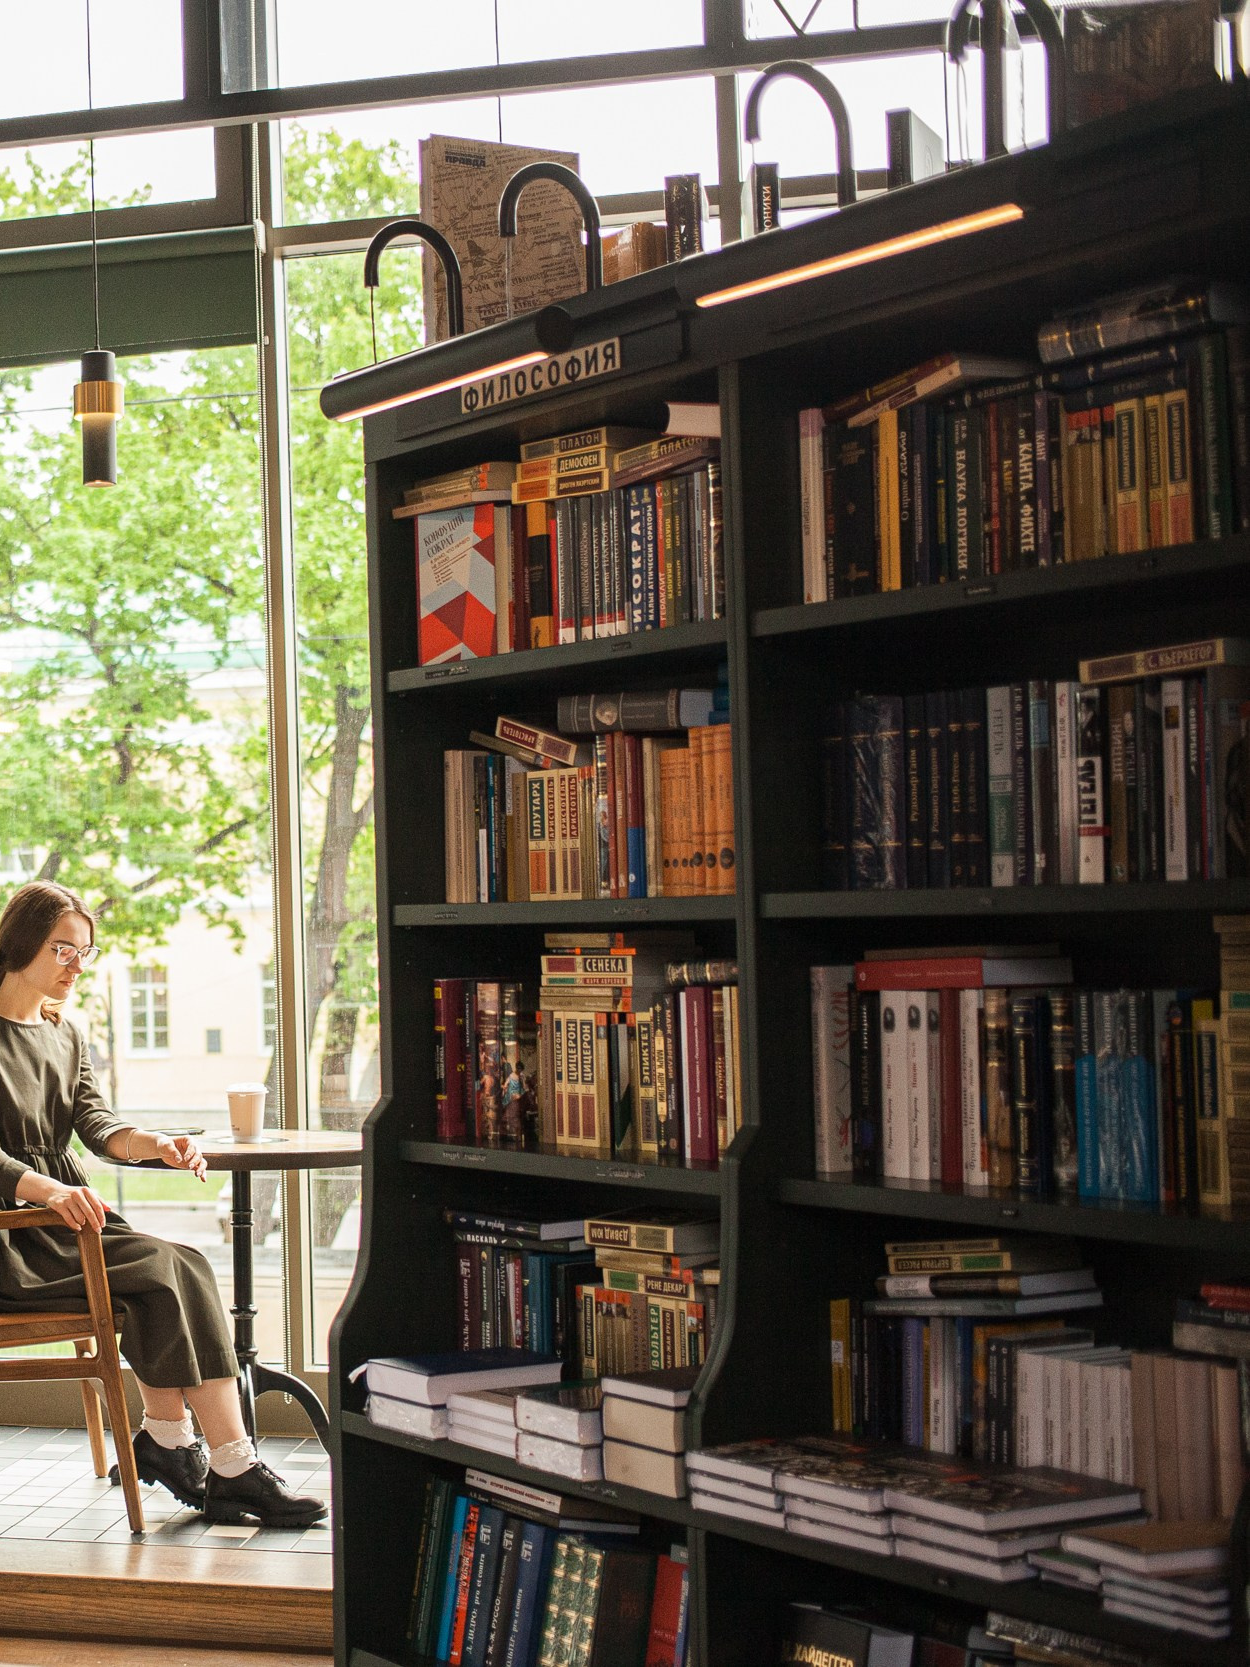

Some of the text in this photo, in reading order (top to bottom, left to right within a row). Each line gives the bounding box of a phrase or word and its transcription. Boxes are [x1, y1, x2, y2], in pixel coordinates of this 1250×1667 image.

[445, 156, 486, 167] ПРАВДА
[463, 341, 617, 413] ФИЛОСОФИЯ
[561, 432, 600, 450] ПЛАТОН
[1121, 415, 1131, 487] ИММАНУИЛ КАНТ
[1149, 412, 1159, 484] ИММАНУИЛ КАНТ
[1172, 405, 1181, 478] ИММАНУИЛ КАНТ
[559, 453, 598, 473] ДЕМОСФЕН
[956, 449, 966, 503] НАУКА
[1019, 443, 1034, 553] КАНТА ФИХТЕ
[424, 512, 465, 547] КОНФУЦИЙ
[427, 534, 455, 557] СОКРАТ
[957, 507, 967, 569] ЛОГИКИ
[630, 510, 642, 623] ИСОКРАТ
[503, 724, 536, 745] АРИСТОТЕЛЬ
[993, 709, 1004, 756] ГЕГЕЛЬ
[1014, 716, 1024, 750] ГЕГЕЛЬ
[532, 782, 541, 837] ПЛУТАРХ
[570, 779, 578, 836] АРИСТОТЕЛЬ
[1077, 760, 1097, 824] ГЕГЕЛЬ
[586, 959, 624, 971] СЕНЕКА
[568, 1023, 578, 1080] ЦИЦЕРОН
[582, 1024, 592, 1081] ЦИЦЕРОН
[640, 1025, 650, 1084] ЭПИКТЕТ
[656, 1049, 664, 1069] МАРК
[466, 1233, 498, 1245] ПАСКАЛЬ
[591, 1227, 629, 1241] ДЭВИД ЮМ
[922, 1260, 949, 1269] БЕРТРАН
[647, 1279, 687, 1295] РЕНЕ ДЕКАРТ
[650, 1308, 660, 1367] ВОЛЬТЕР
[479, 1553, 487, 1578] contra
[473, 1589, 484, 1605] pro
[491, 1594, 502, 1628] РУССО:
[507, 1619, 519, 1635] pro
[514, 1588, 523, 1611] contra
[468, 1607, 479, 1643] ДИДРО:
[487, 1629, 498, 1654] Ж.-Ж.
